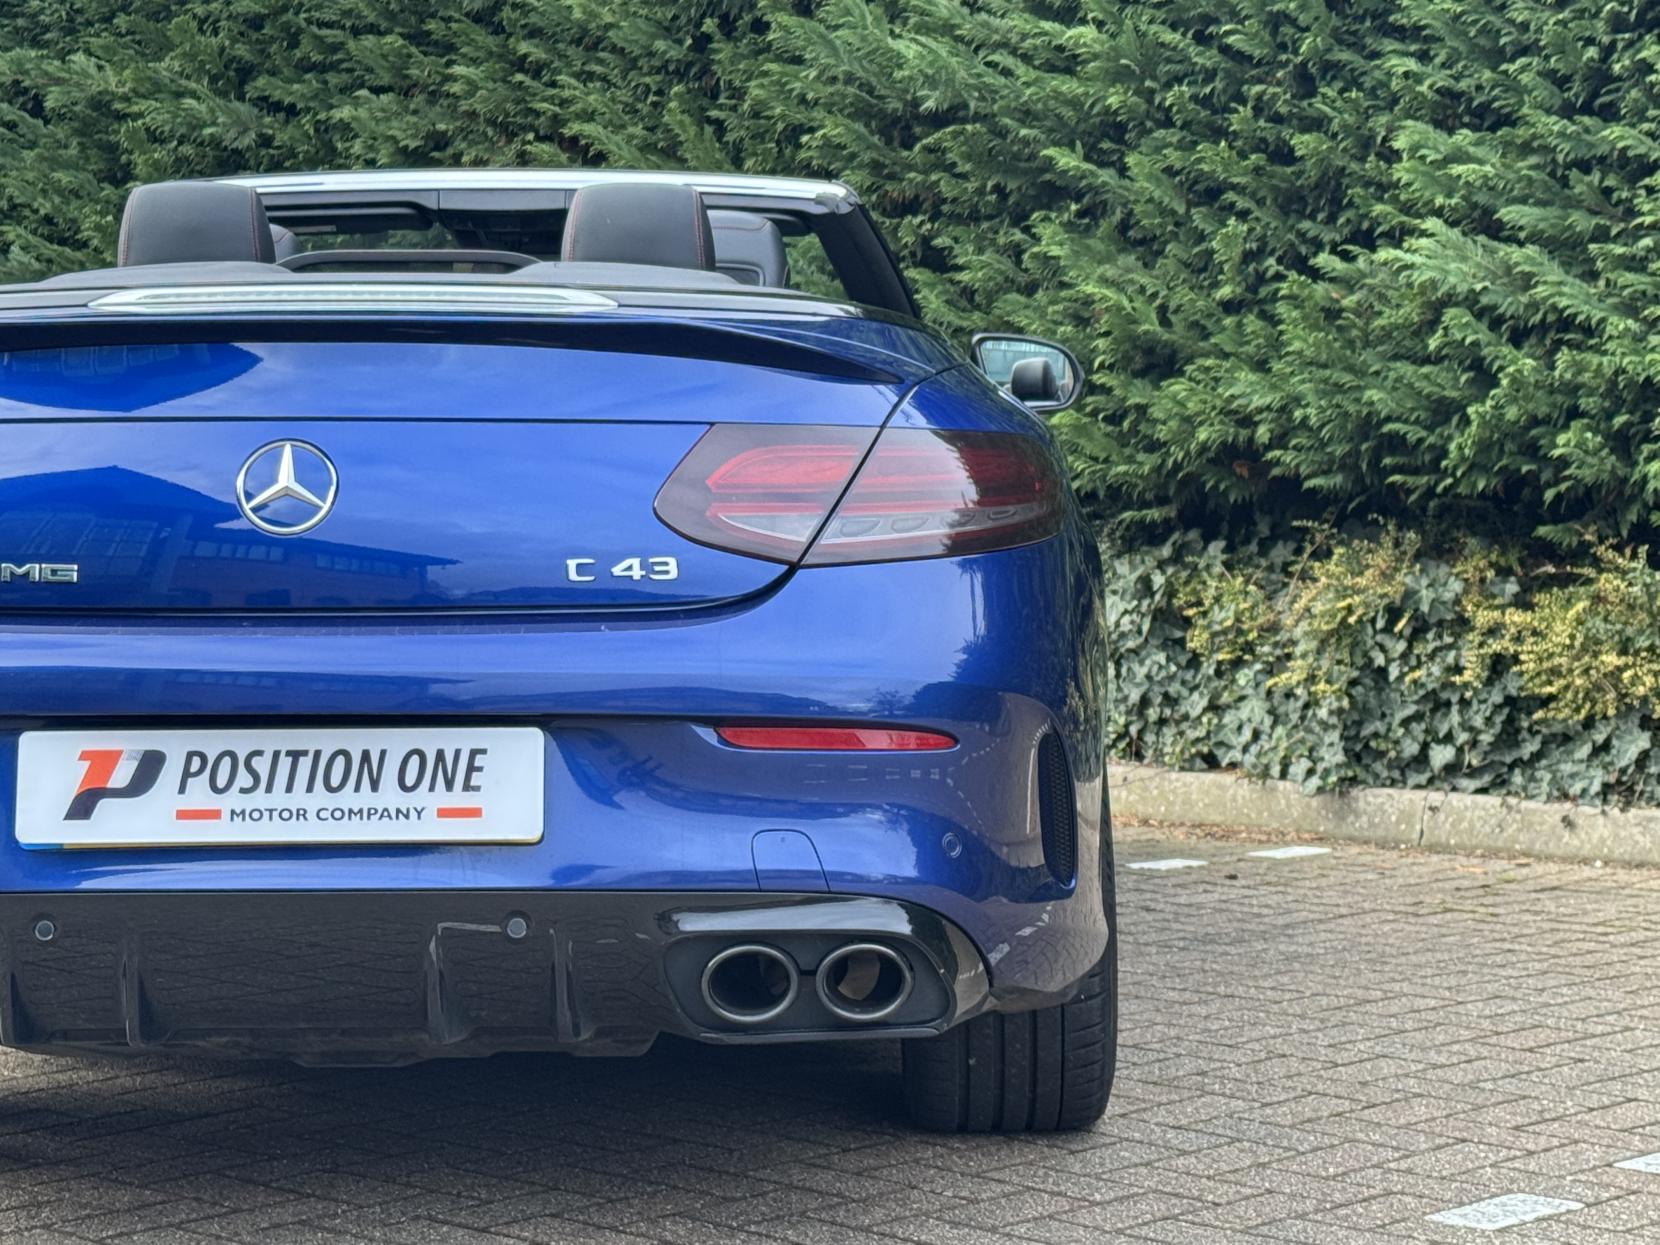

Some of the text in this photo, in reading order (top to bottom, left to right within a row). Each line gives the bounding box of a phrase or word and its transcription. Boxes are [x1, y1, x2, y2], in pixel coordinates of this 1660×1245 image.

[566, 557, 678, 581] C 43
[177, 747, 488, 795] POSITION ONE
[229, 806, 426, 822] MOTOR COMPANY
